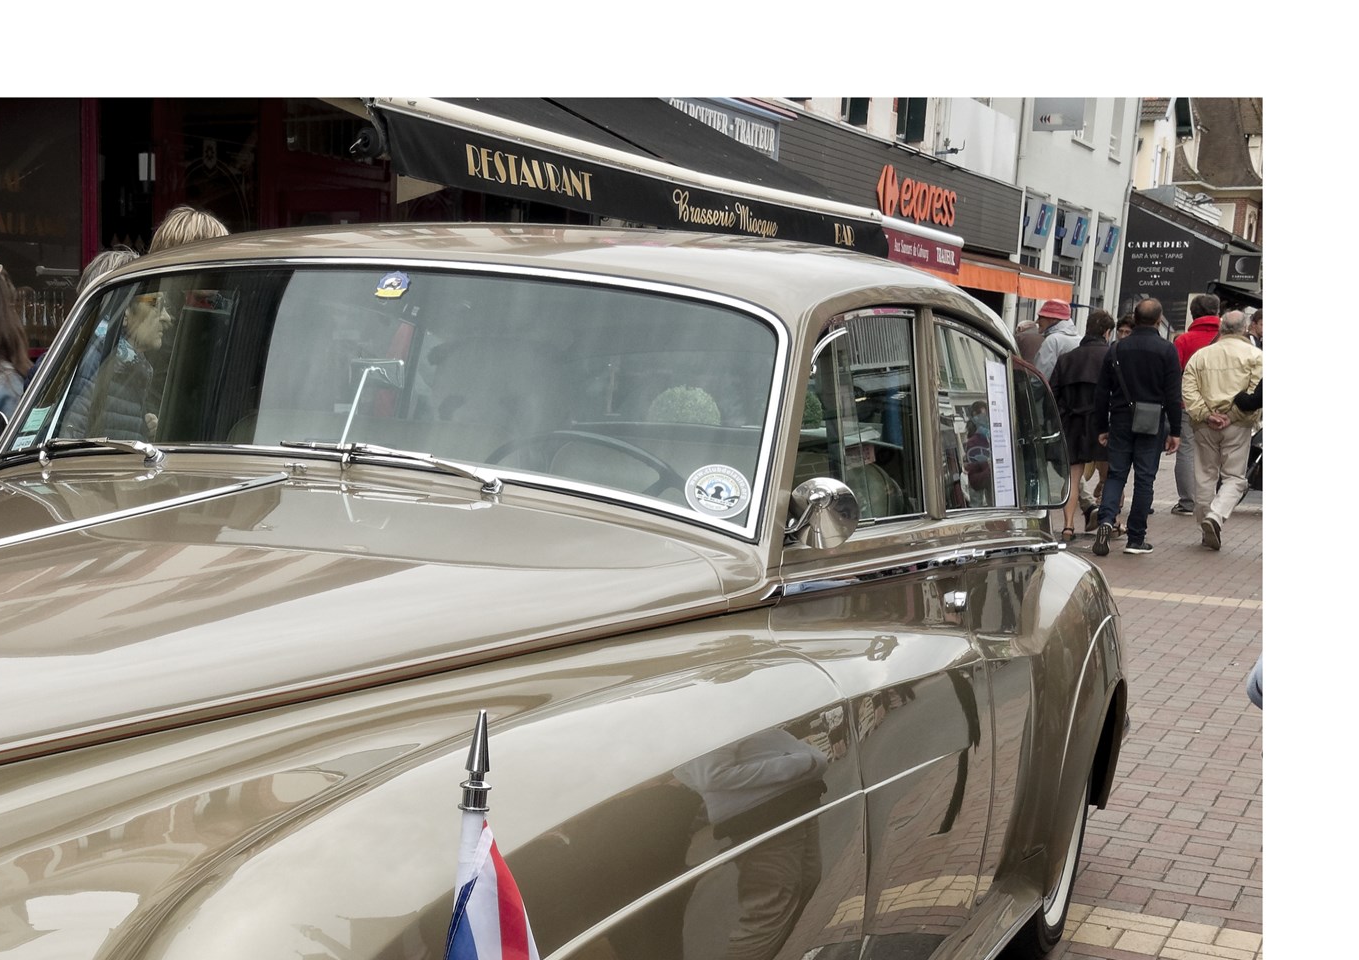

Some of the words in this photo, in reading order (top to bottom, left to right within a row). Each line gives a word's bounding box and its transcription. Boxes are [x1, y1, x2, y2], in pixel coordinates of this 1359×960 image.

[734, 117, 776, 152] TRAITEUR
[465, 143, 593, 201] RESTAURANT
[673, 188, 736, 228] Brasserie
[735, 202, 779, 238] Miocque
[900, 177, 957, 228] express
[834, 223, 855, 247] BAR
